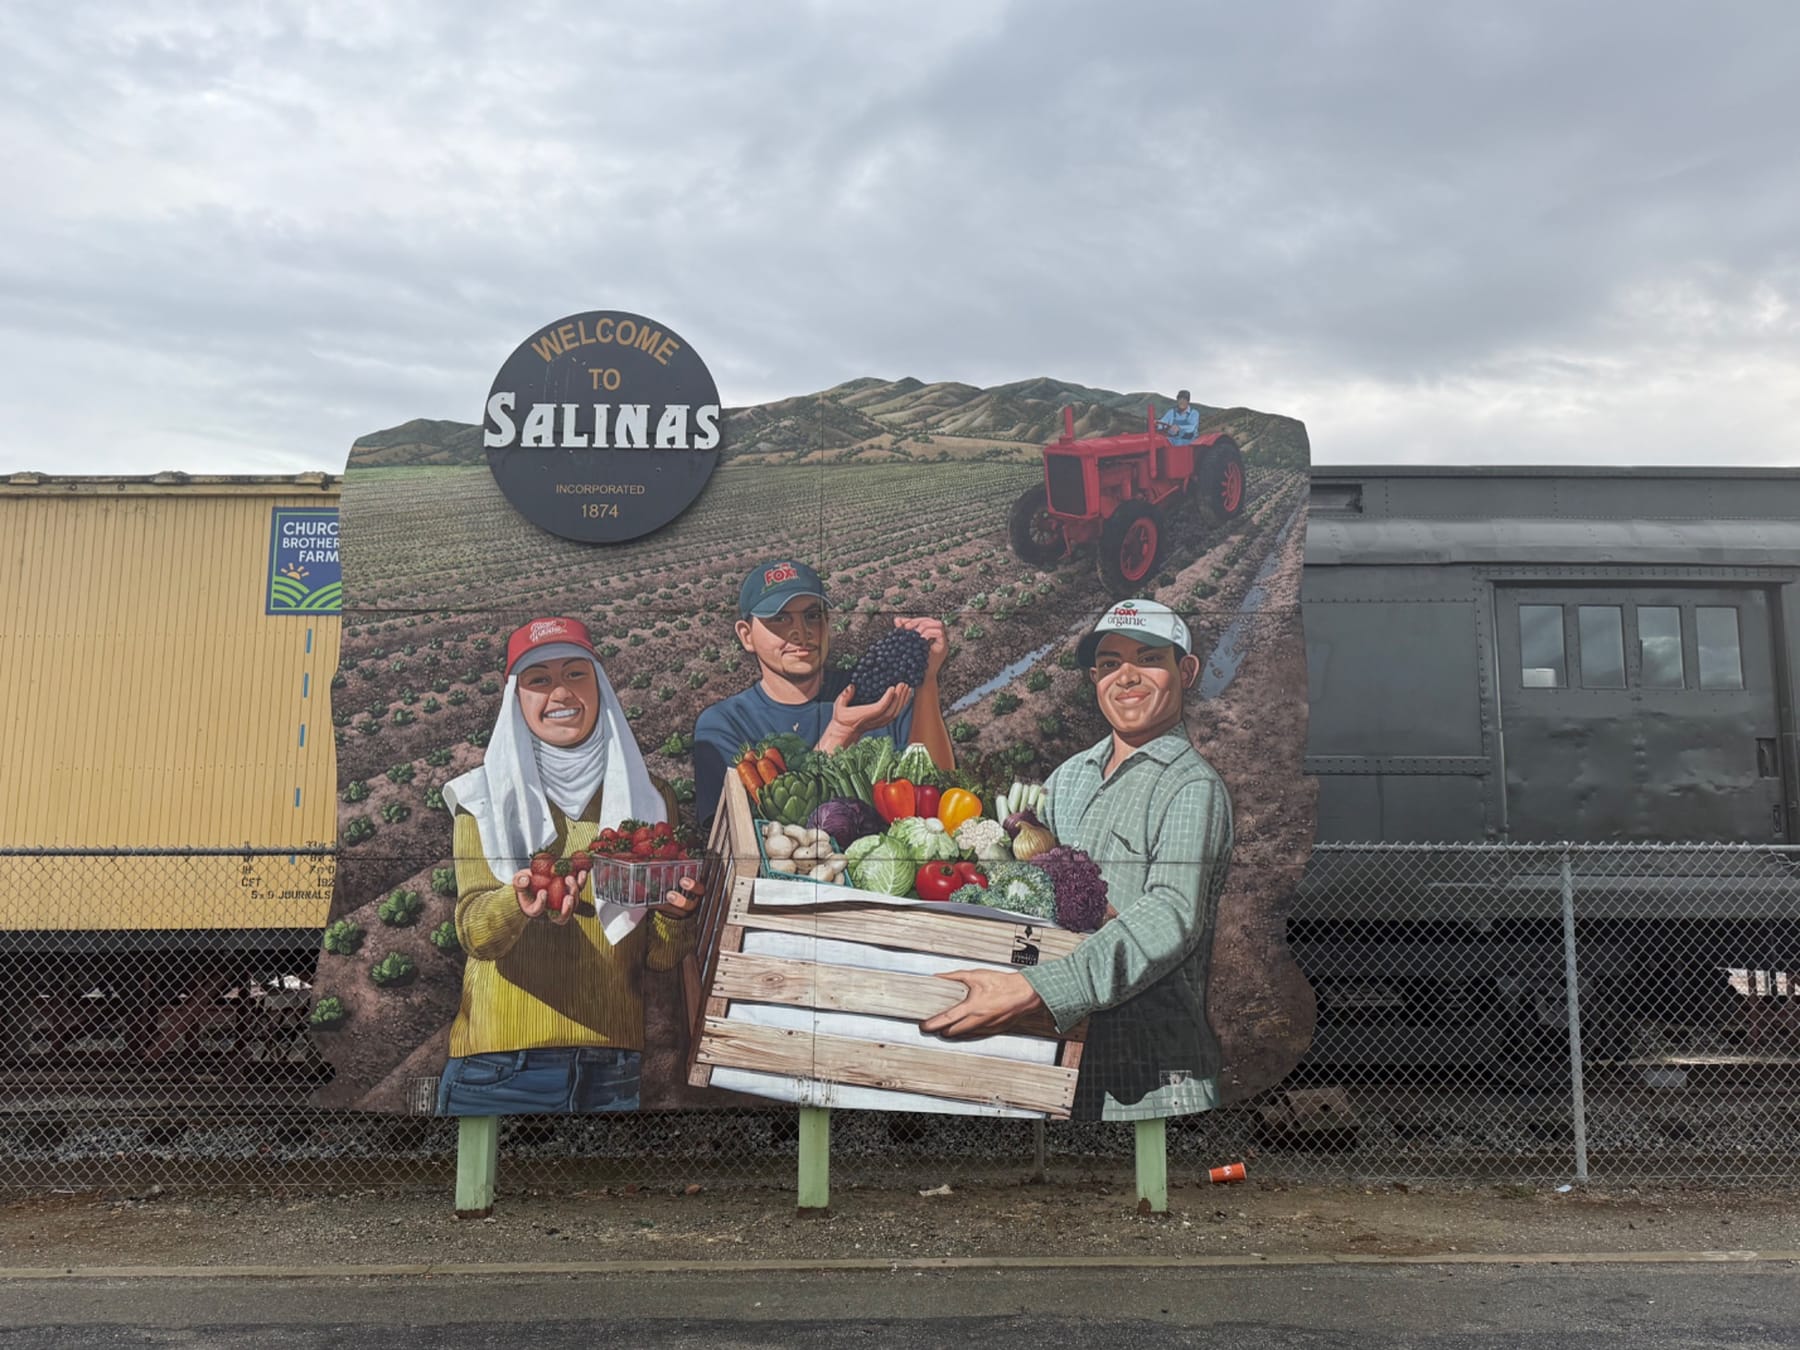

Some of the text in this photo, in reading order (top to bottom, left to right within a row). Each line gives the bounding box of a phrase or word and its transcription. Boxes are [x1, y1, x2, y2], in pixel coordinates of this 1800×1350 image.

[531, 318, 680, 365] WELCOME
[588, 368, 622, 390] TO
[555, 483, 646, 495] INCORPORATED
[581, 503, 619, 518] 1874
[298, 550, 339, 562] FARM
[1107, 616, 1147, 627] organic
